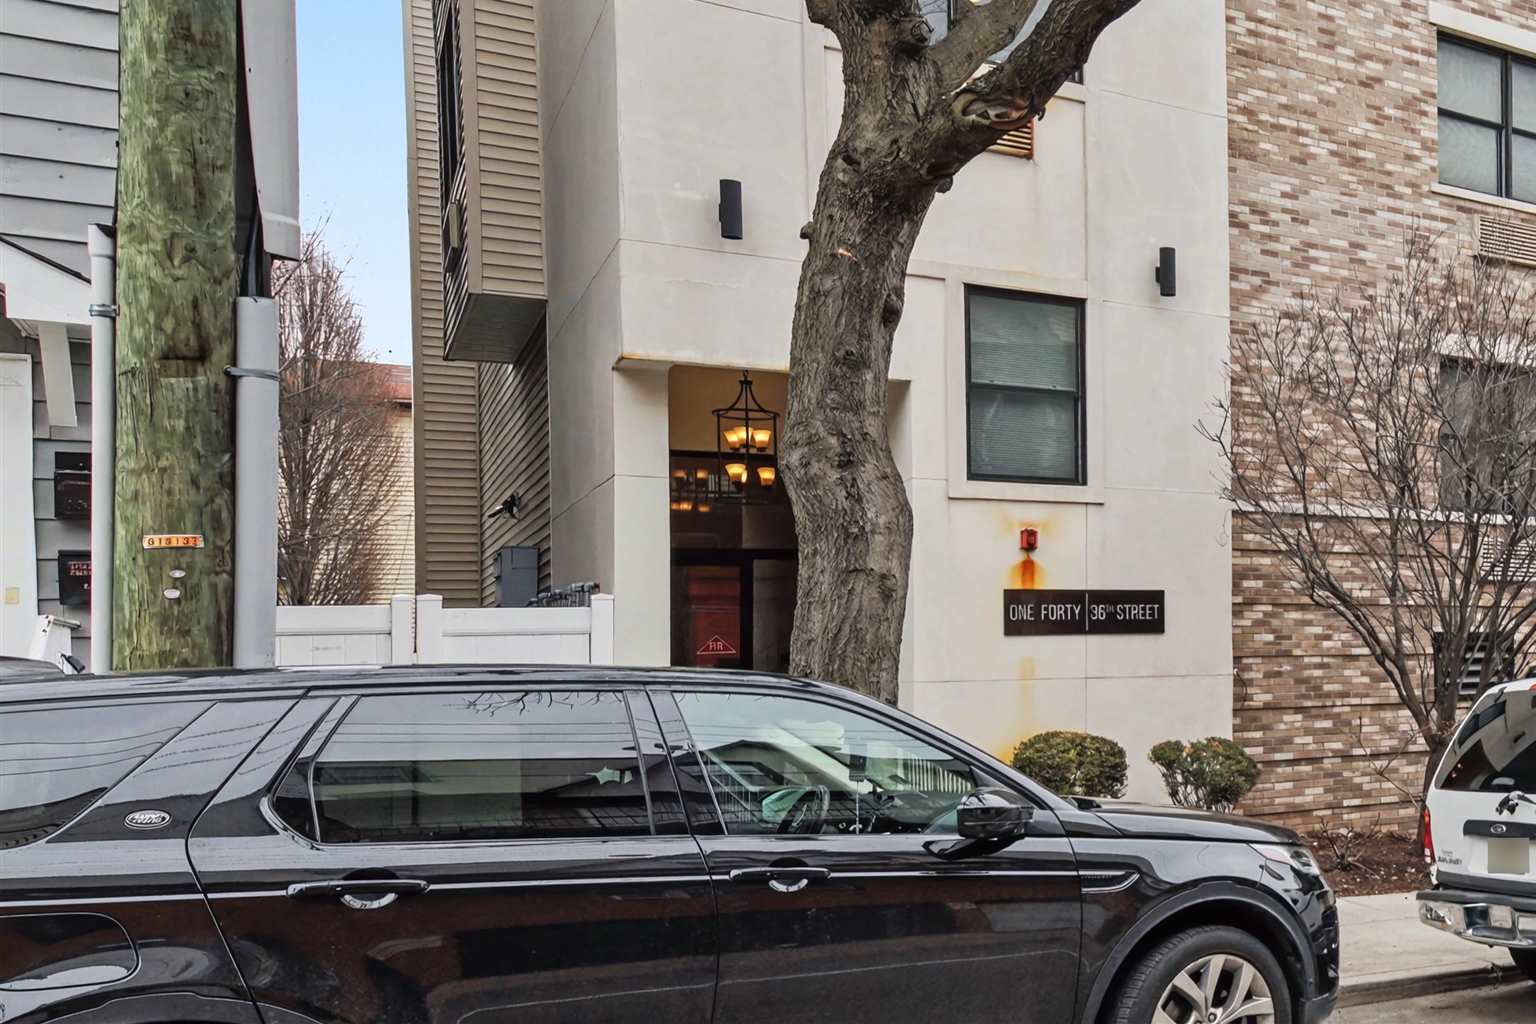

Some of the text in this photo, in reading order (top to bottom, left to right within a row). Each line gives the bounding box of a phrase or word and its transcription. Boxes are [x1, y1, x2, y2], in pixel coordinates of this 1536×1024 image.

[1009, 604, 1035, 621] ONE
[1041, 604, 1081, 621] FORTY
[1116, 604, 1160, 620] STREET
